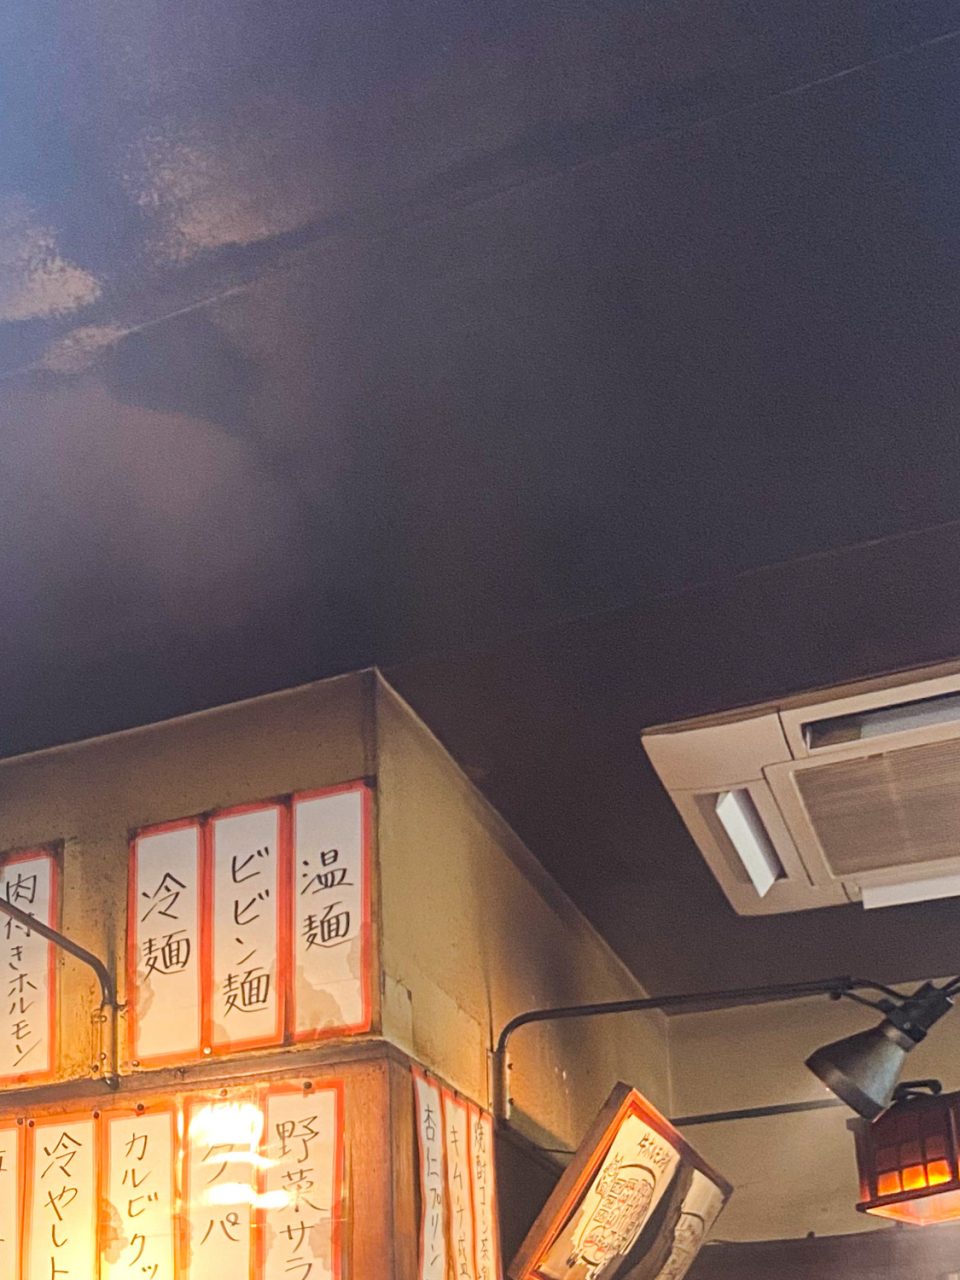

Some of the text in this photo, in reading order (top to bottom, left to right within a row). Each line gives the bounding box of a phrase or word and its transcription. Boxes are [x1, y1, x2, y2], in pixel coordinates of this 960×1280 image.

[141, 873, 191, 980] 冷麺
[224, 848, 271, 1016] ビビン麺
[301, 849, 354, 951] 温麺
[5, 873, 42, 1067] 肉付きホルモン
